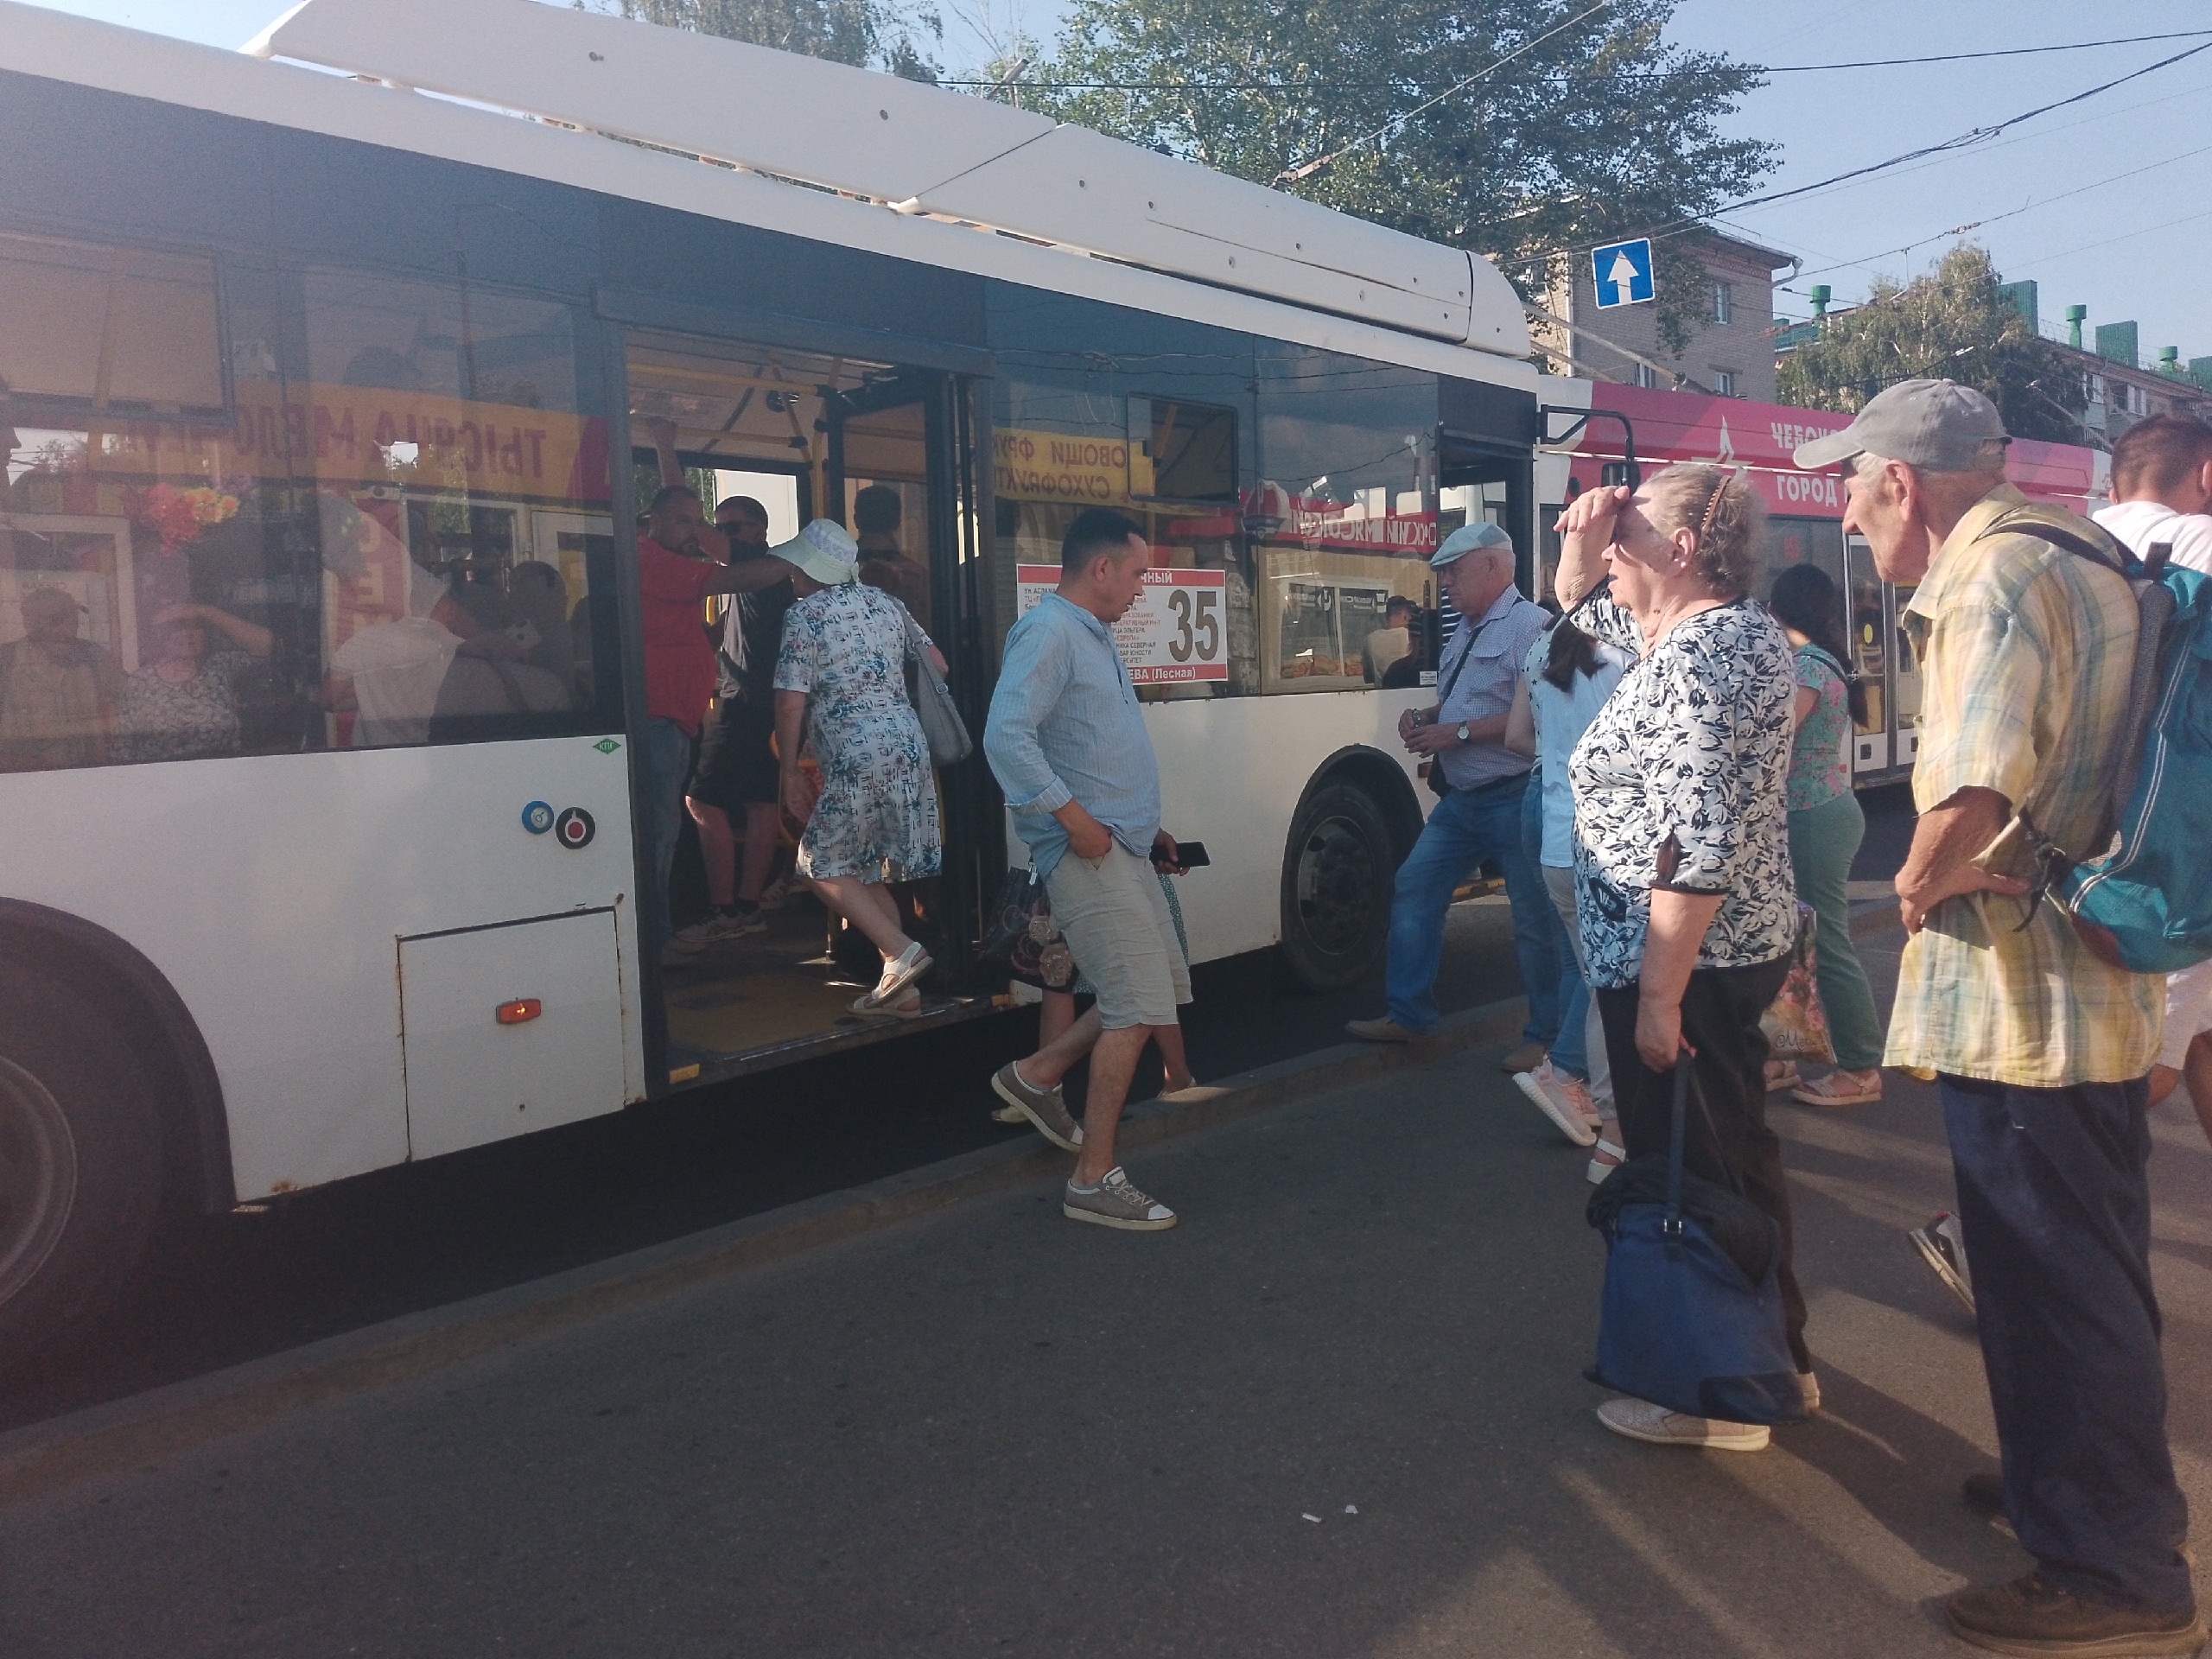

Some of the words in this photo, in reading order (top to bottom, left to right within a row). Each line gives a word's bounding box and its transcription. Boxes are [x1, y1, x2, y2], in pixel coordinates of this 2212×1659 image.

[1770, 422, 1839, 449] ЧЕБО
[1777, 474, 1838, 507] ГОРОД
[1167, 589, 1218, 662] 35
[1152, 666, 1196, 682] (Лесная)
[599, 741, 614, 751] КПГ
